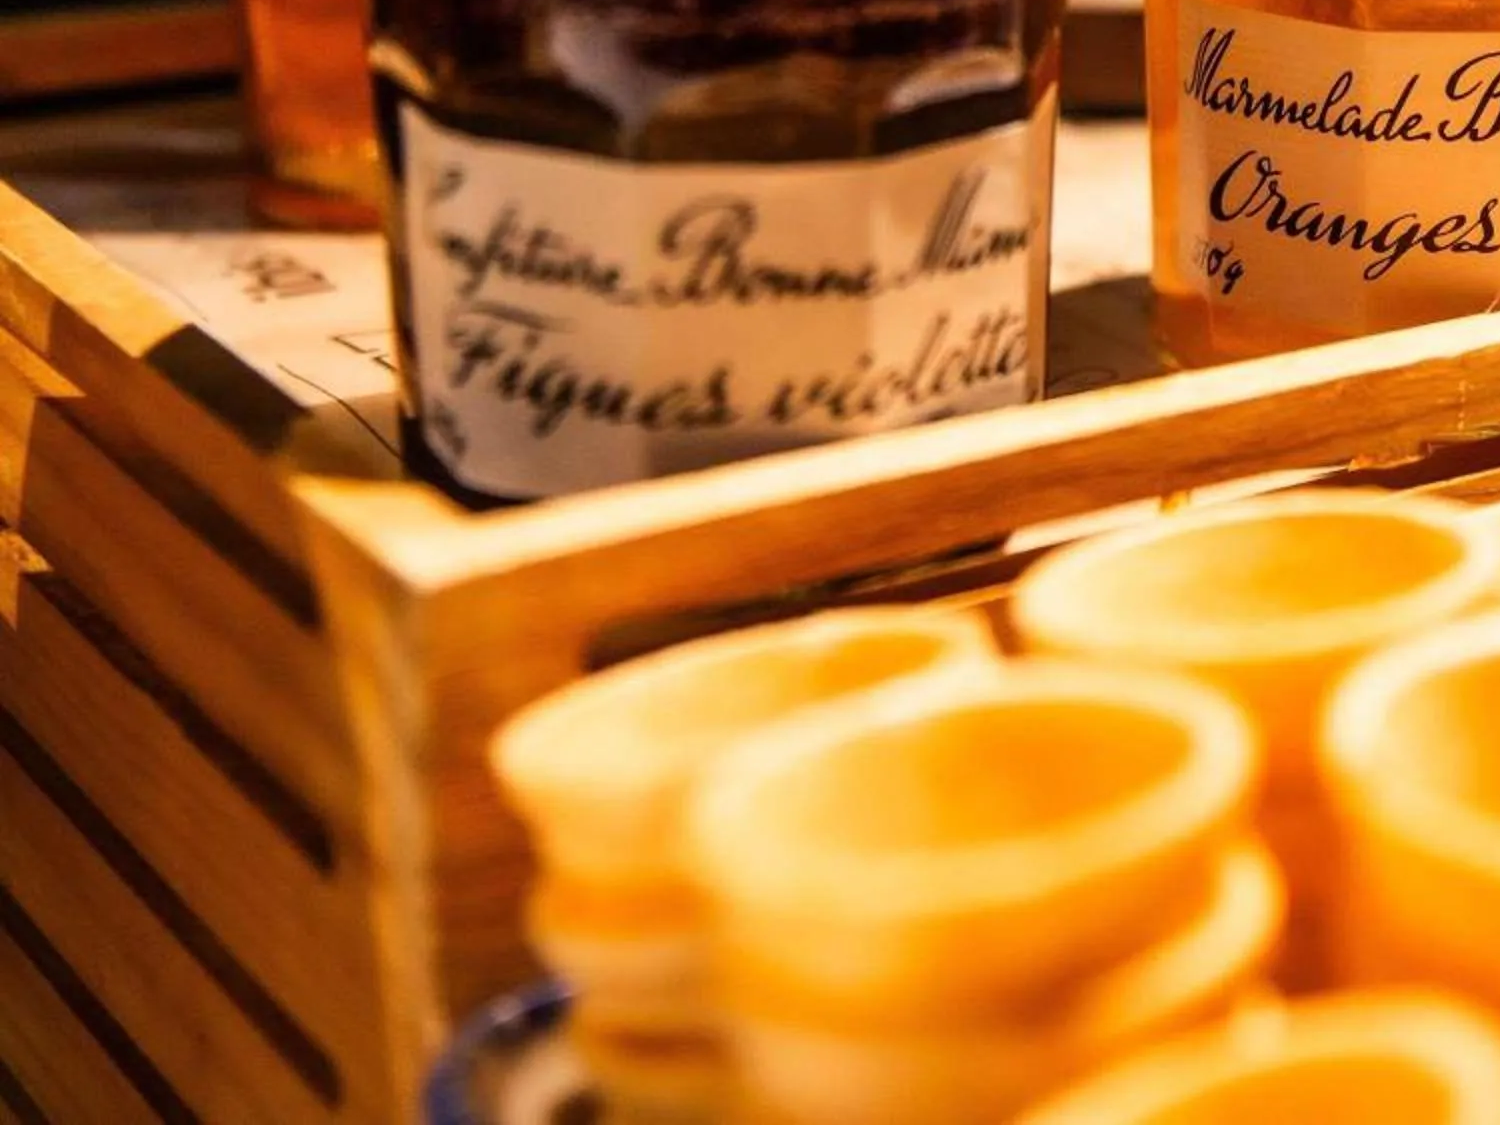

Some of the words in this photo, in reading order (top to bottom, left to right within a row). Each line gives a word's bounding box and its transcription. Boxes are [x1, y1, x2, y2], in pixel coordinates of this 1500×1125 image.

[1184, 25, 1430, 143] Marmelade
[648, 193, 884, 309] Bonne
[446, 299, 742, 443] Figues
